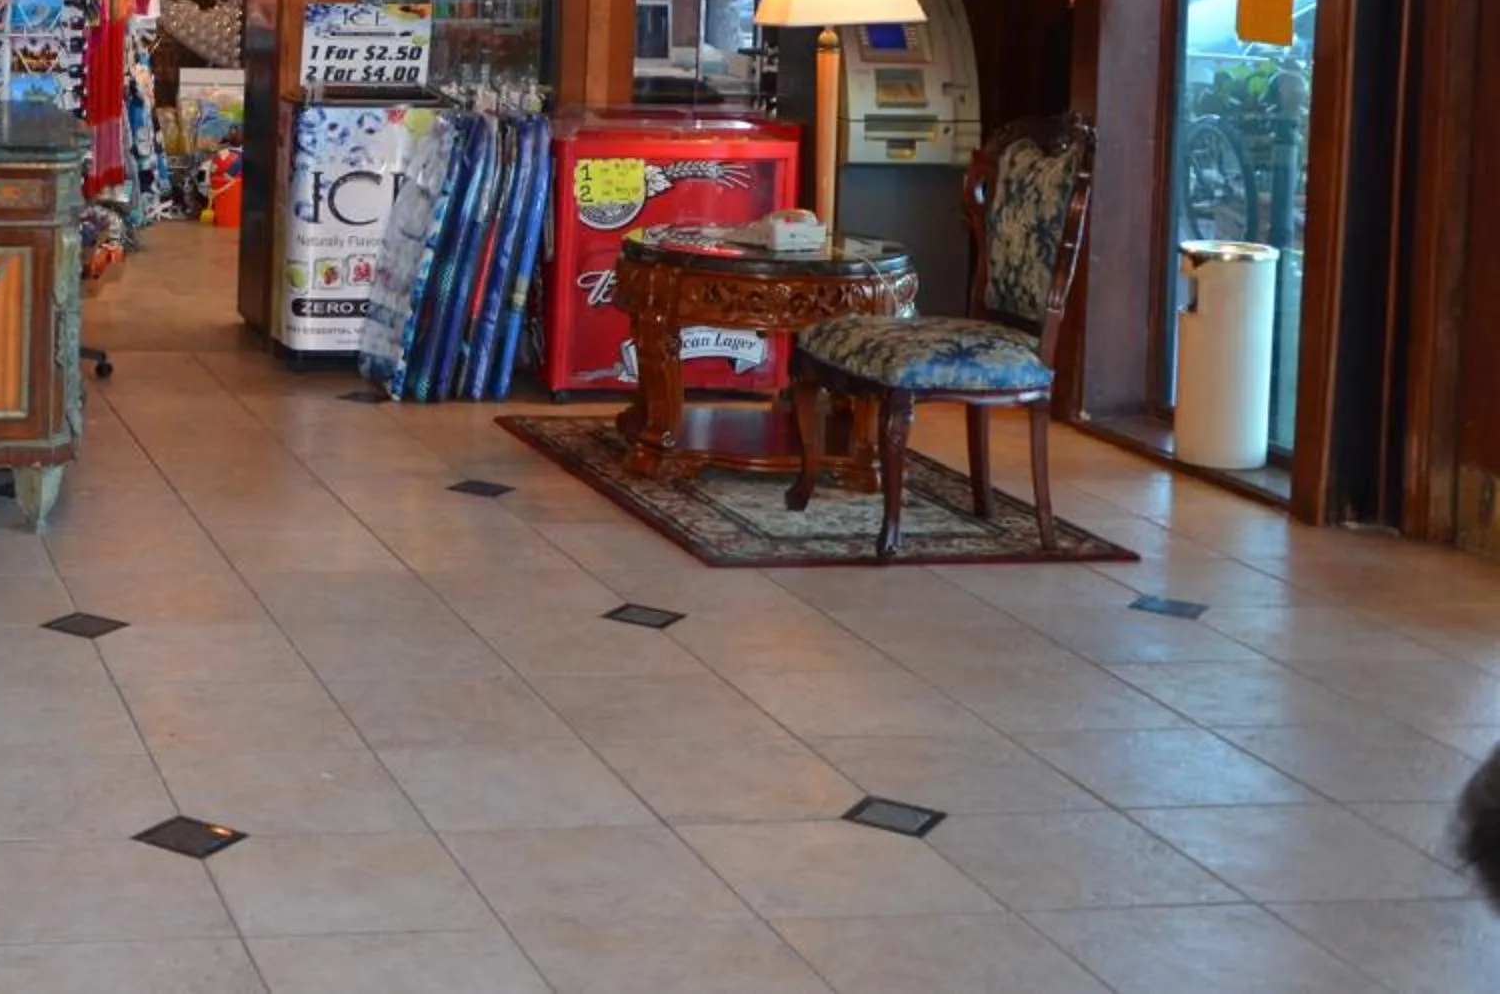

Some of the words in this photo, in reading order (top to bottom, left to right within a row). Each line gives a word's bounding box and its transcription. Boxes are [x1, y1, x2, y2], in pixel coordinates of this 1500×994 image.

[310, 46, 320, 60] 1
[324, 45, 359, 60] For
[363, 45, 423, 61] $2.50
[305, 66, 318, 81] 2
[323, 66, 356, 81] For
[361, 66, 421, 82] $4.00
[580, 164, 593, 180] 1
[580, 185, 594, 203] 2
[300, 301, 354, 315] ZERO
[713, 331, 757, 351] Lager
